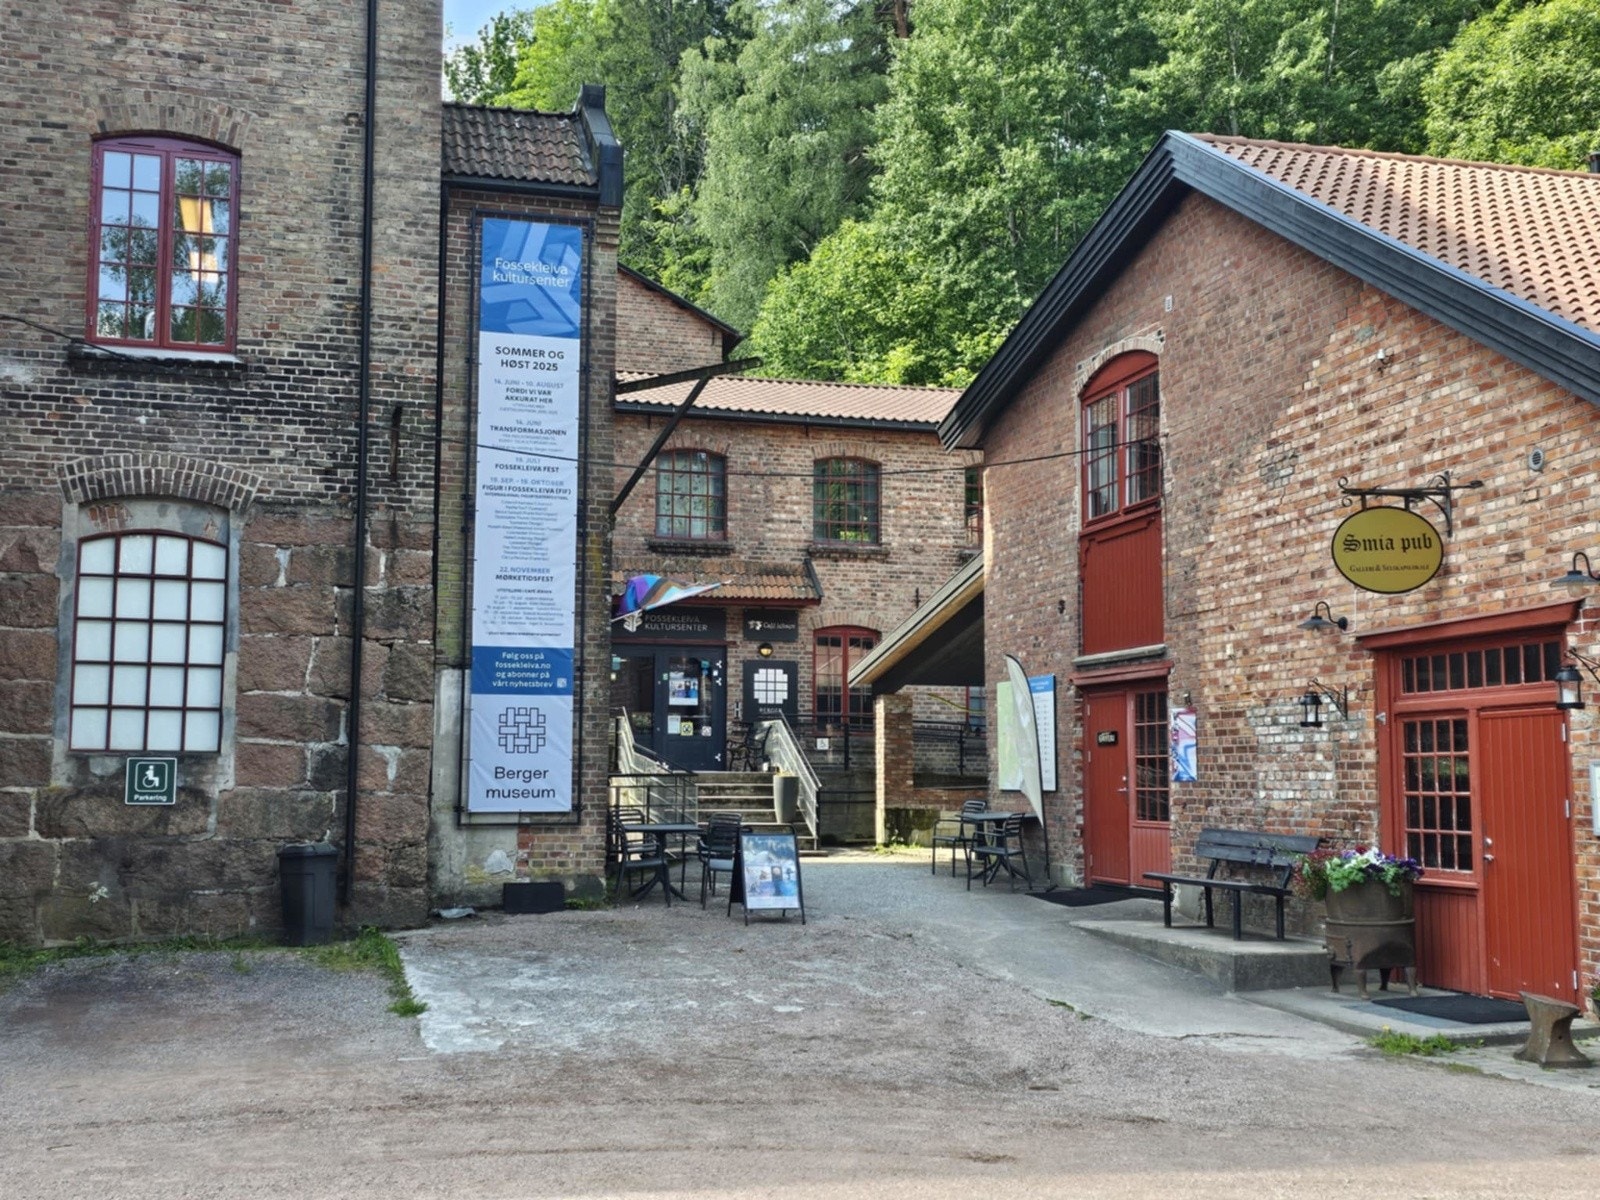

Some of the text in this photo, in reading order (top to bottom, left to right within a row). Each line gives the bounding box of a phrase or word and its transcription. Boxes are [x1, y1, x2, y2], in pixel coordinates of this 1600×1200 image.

[494, 257, 568, 274] Fossekleiva
[492, 270, 570, 288] kultursenter
[495, 346, 564, 360] SOMMER OG
[500, 359, 558, 372] HØST 2025
[490, 425, 567, 436] TRANSFORMASJONEN
[495, 464, 543, 472] FOSSEKLEIVA
[1343, 533, 1432, 553] Smia pub
[645, 623, 708, 632] KULTURSENTER
[502, 652, 519, 661] Følg
[534, 652, 544, 661] på
[495, 661, 550, 669] fossekleiva.no
[540, 671, 550, 679] på
[492, 679, 553, 688] vårt nyhetsbrev
[494, 766, 548, 783] Berger
[133, 794, 168, 802] Parkering
[486, 788, 556, 798] museum
